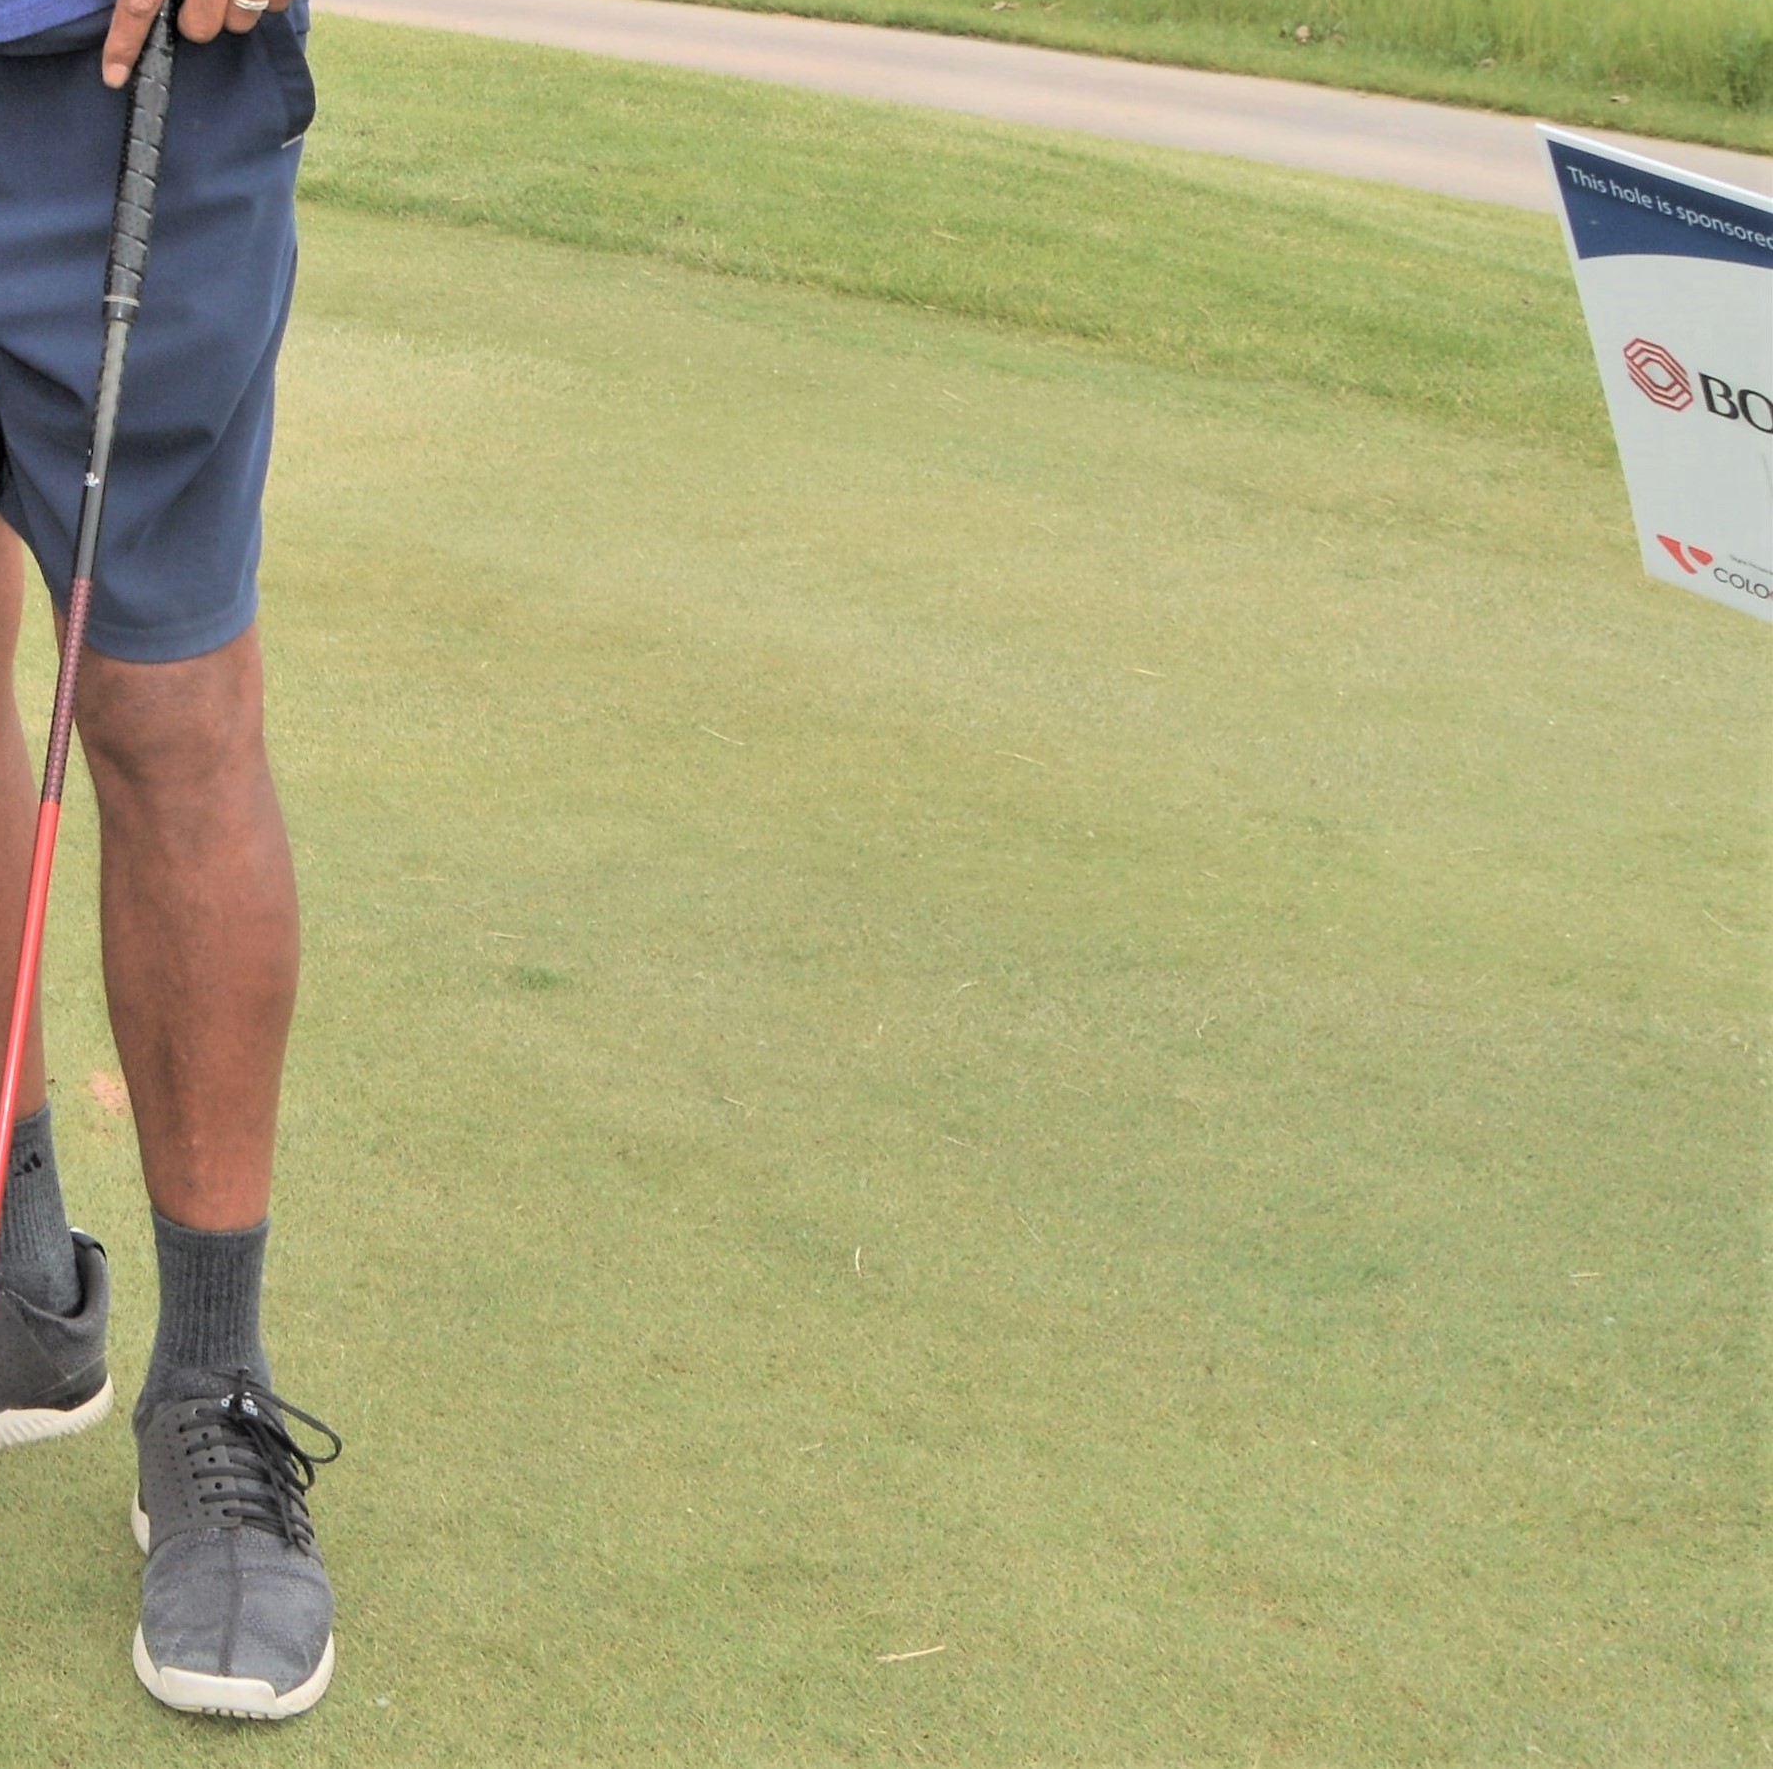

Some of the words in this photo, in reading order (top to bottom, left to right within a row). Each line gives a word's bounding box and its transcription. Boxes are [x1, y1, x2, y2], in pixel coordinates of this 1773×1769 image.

[1566, 165, 1606, 194] This
[1609, 179, 1653, 209] hole
[1655, 195, 1672, 215] is
[1713, 567, 1773, 600] COLO
